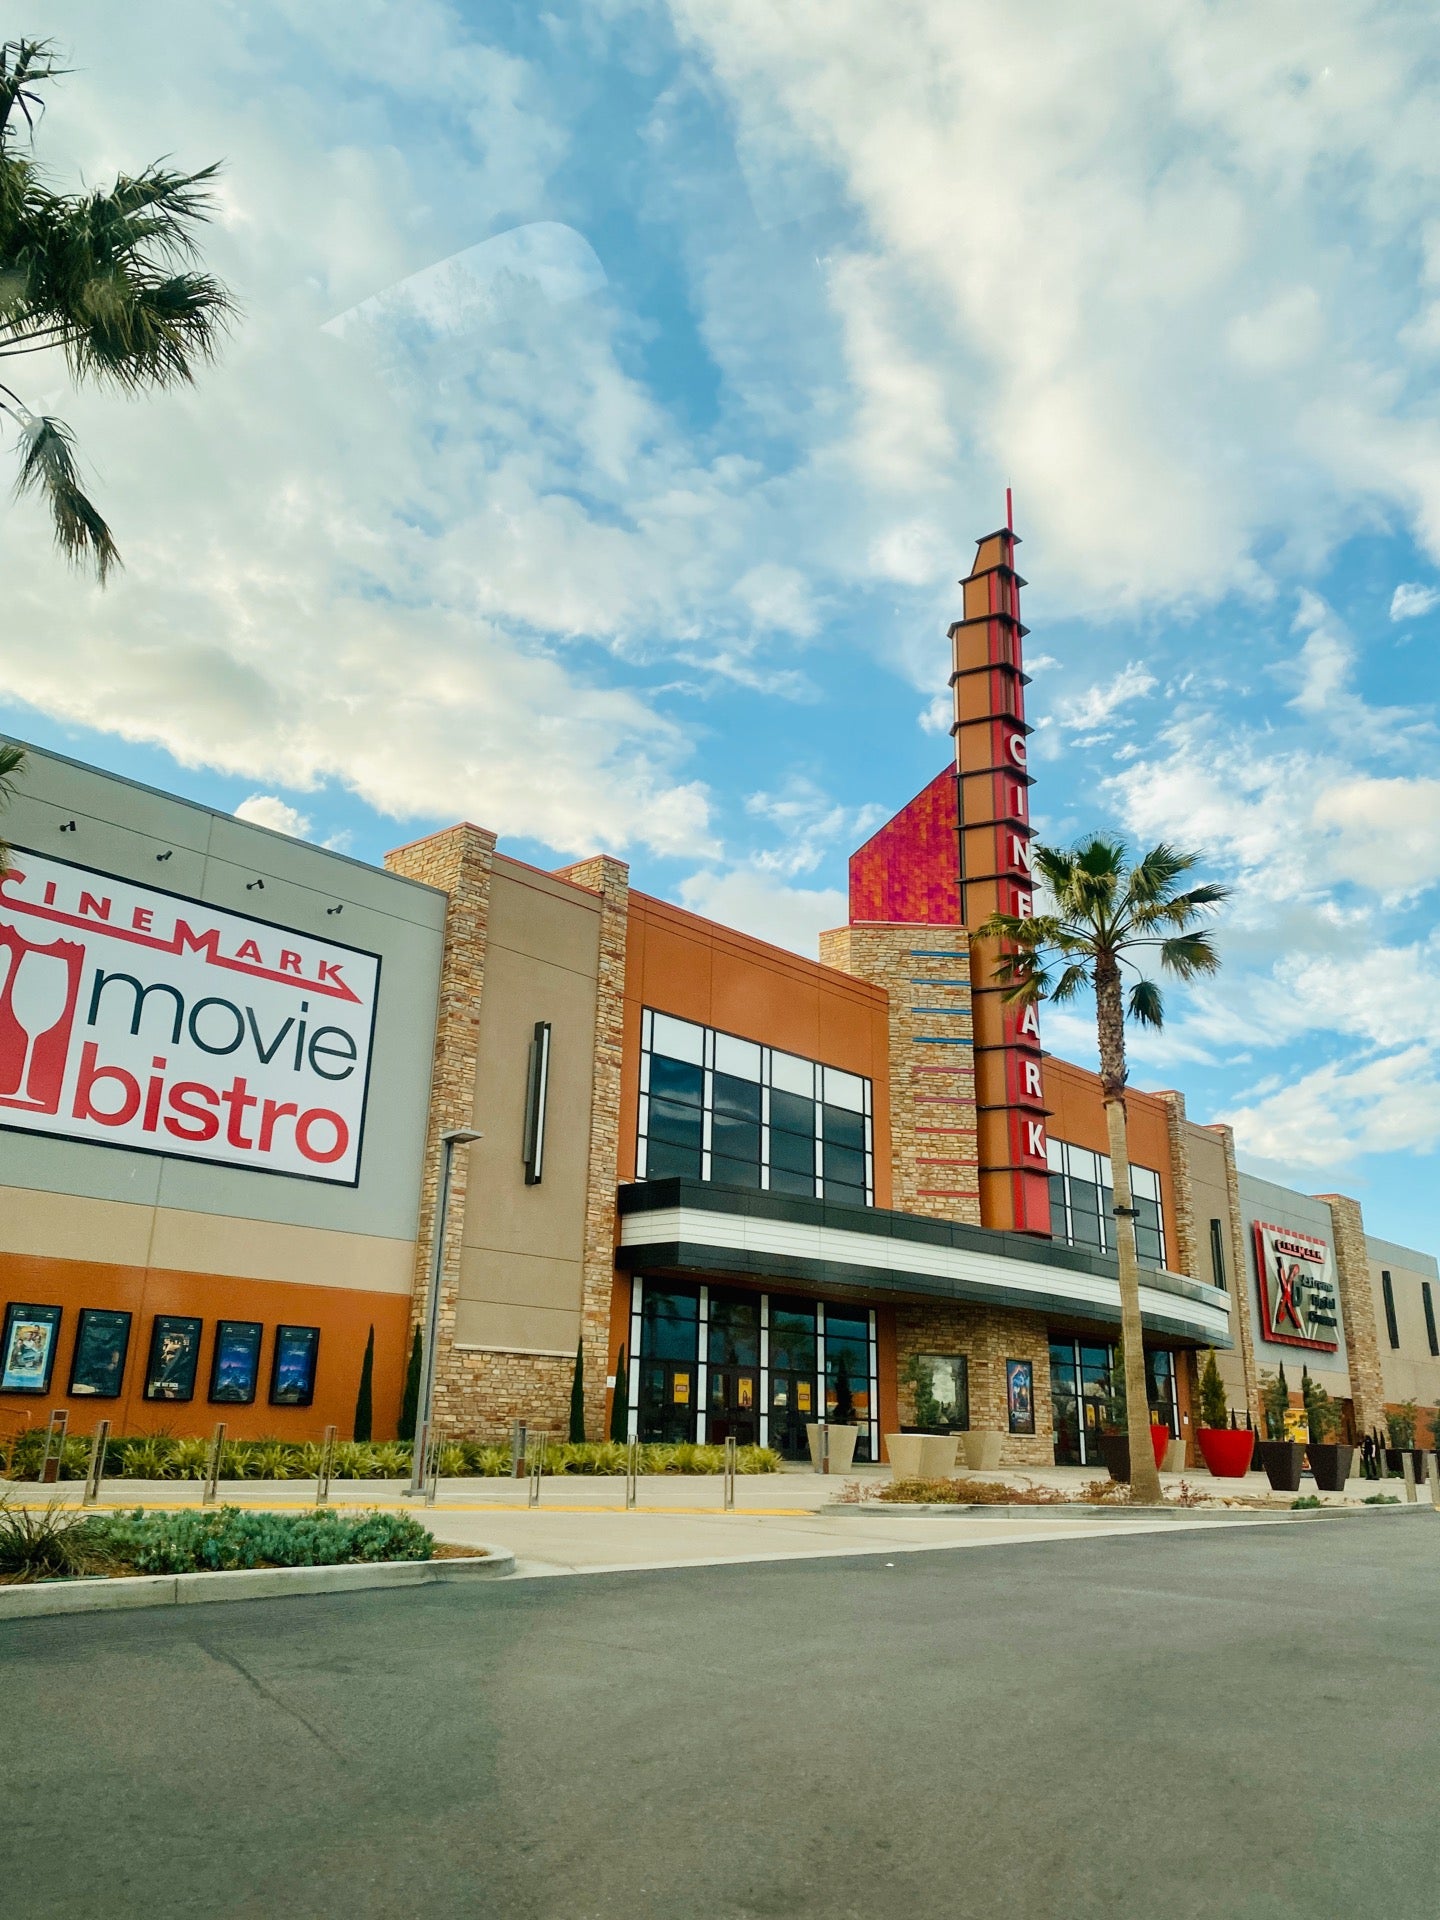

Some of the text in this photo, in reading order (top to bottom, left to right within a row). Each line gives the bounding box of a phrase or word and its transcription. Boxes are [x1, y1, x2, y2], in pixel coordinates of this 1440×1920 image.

[0, 869, 363, 1004] CINEMARK
[1007, 733, 1046, 1158] CINEARK
[87, 968, 358, 1081] movie
[71, 1040, 349, 1164] bistro
